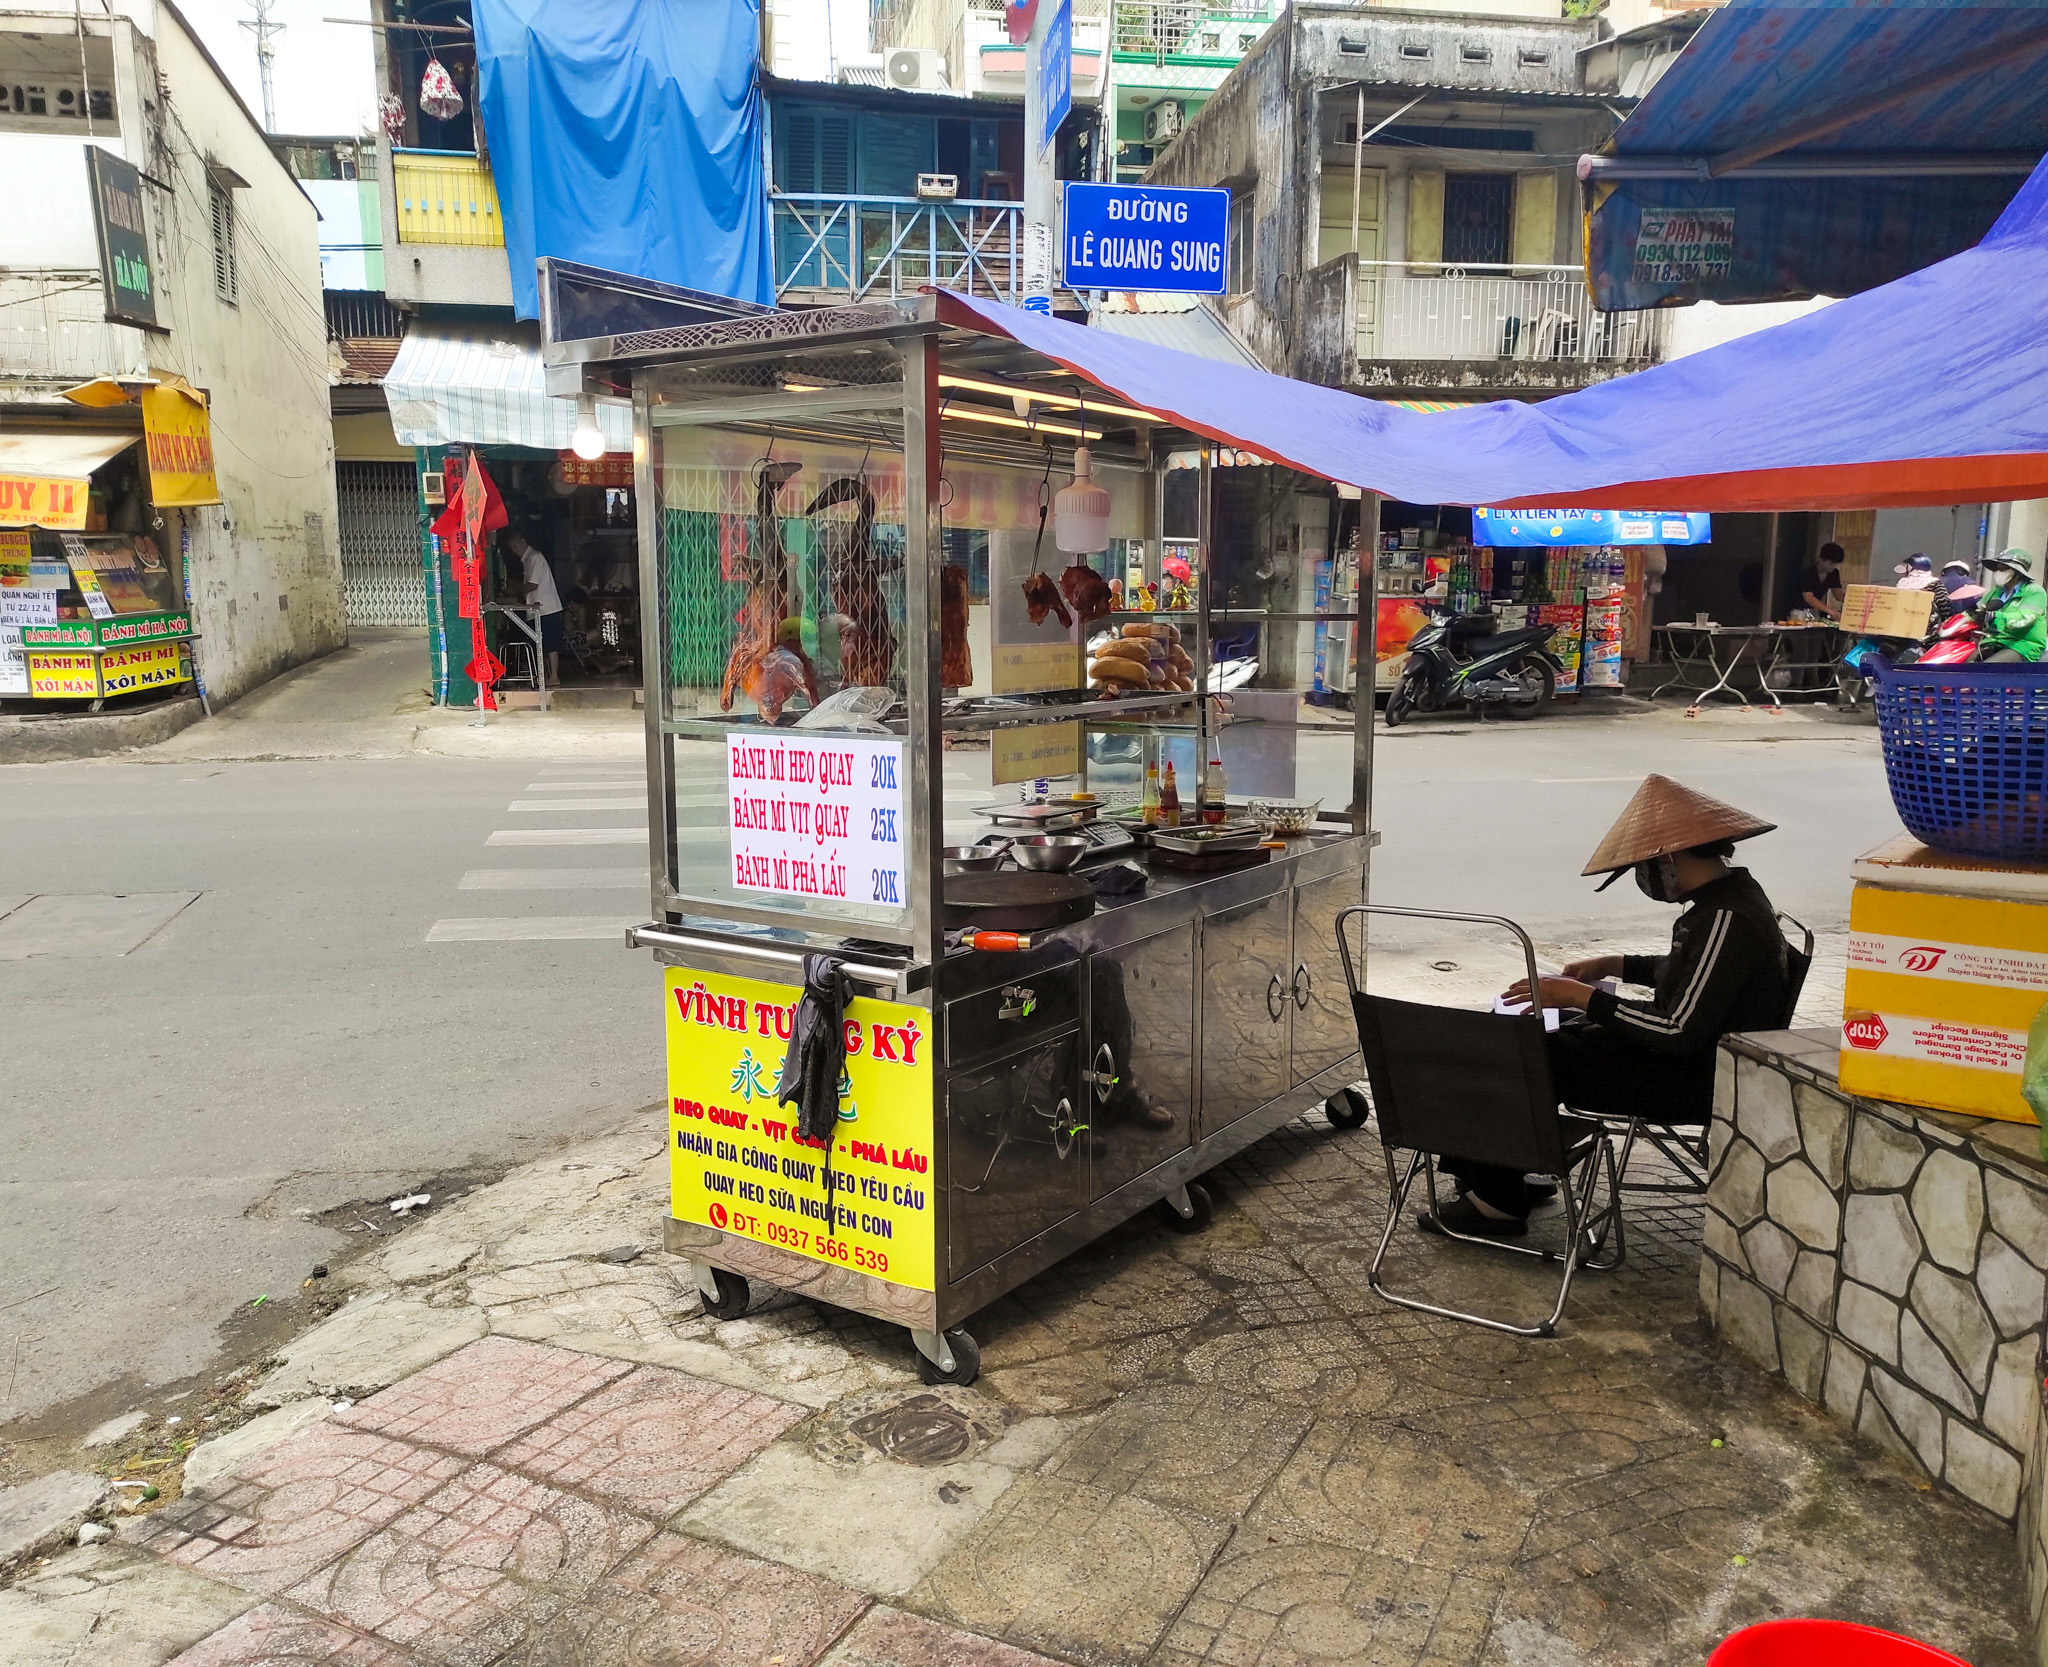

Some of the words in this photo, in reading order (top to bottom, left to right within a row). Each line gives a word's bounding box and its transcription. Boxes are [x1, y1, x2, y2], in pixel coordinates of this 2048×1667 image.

[1107, 193, 1188, 224] ĐƯỜNG
[1071, 230, 1094, 267] LÊ
[1100, 237, 1162, 270] QUANG
[1171, 240, 1220, 273] SUNG
[1561, 508, 1586, 519] TAY
[23, 589, 40, 600] NGHỈ
[42, 590, 56, 600] TẾT
[26, 627, 50, 643] BÁNH
[51, 627, 61, 643] MÌ
[63, 627, 75, 643] HÀ
[76, 627, 92, 645] NỘI
[102, 623, 135, 641] BÁNH
[138, 621, 151, 637] MÌ
[152, 618, 168, 634] HÀ
[169, 615, 188, 635] NỘI
[32, 654, 72, 669] BÁNH
[76, 654, 92, 669] MÌ
[103, 652, 152, 669] BÁNH
[157, 642, 175, 658] MÌ
[35, 678, 60, 692] XÔI
[63, 678, 94, 694] MẶN
[105, 673, 136, 692] XÔI
[141, 667, 176, 684] MẶN
[732, 738, 766, 780] BÁNH
[769, 740, 785, 781] MÌ
[789, 751, 815, 783] HEO
[819, 751, 854, 794] QUAY
[871, 754, 897, 789] 20K
[734, 788, 767, 830] BÁNH
[771, 791, 786, 832] MÌ
[789, 801, 811, 842] VỊT
[815, 803, 849, 845] QUAY
[871, 807, 897, 842] 25K
[736, 846, 770, 887] BÁNH
[773, 849, 788, 890] MÌ
[792, 852, 818, 893] PHÁ
[821, 848, 846, 897] LẤU
[872, 868, 899, 903] 20K
[1954, 952, 1980, 962] CÔNG
[1983, 956, 1995, 965] TY
[1997, 958, 2024, 968] TNHH
[1947, 967, 1971, 976] Chuyên
[1972, 970, 1991, 979] thùng
[2030, 976, 2043, 984] tấm
[674, 982, 748, 1031] VĨNH
[753, 1000, 864, 1055] TƯG
[870, 1019, 923, 1065] KÝ
[1850, 1023, 1882, 1040] STOP
[1931, 1023, 1969, 1036] Receipt
[1912, 1030, 1944, 1041] Before
[1947, 1035, 1992, 1047] Contents
[1971, 1028, 2009, 1041] Signing
[1915, 1039, 1961, 1052] Damaged
[1964, 1044, 2007, 1059] Package
[1994, 1040, 2027, 1052] Check
[1926, 1049, 1962, 1061] Broken
[1965, 1054, 1974, 1062] Is
[1976, 1055, 1998, 1066] Seal
[1999, 1058, 2008, 1067] If
[2009, 1052, 2022, 1060] Or
[674, 1097, 704, 1120] HEO
[708, 1105, 748, 1131] QUAY
[762, 1118, 787, 1143] VỊT
[851, 1139, 887, 1166] PHÁ
[892, 1145, 928, 1174] LẤU
[677, 1130, 713, 1159] NHẬN
[716, 1140, 738, 1164] GIA
[741, 1144, 778, 1174] CÔNG
[781, 1157, 816, 1184] QUAY
[819, 1166, 856, 1194] THEO
[860, 1175, 888, 1202] YÊU
[893, 1182, 925, 1211] CẦU
[703, 1170, 735, 1196] QUAY
[739, 1179, 764, 1205] HEO
[768, 1186, 796, 1214] SỮA
[800, 1196, 857, 1230] NGUYÊN
[861, 1213, 893, 1240] CON
[733, 1212, 762, 1238] ĐT:
[767, 1223, 808, 1250] 0937
[816, 1235, 849, 1262] 566
[854, 1246, 889, 1273] 539
